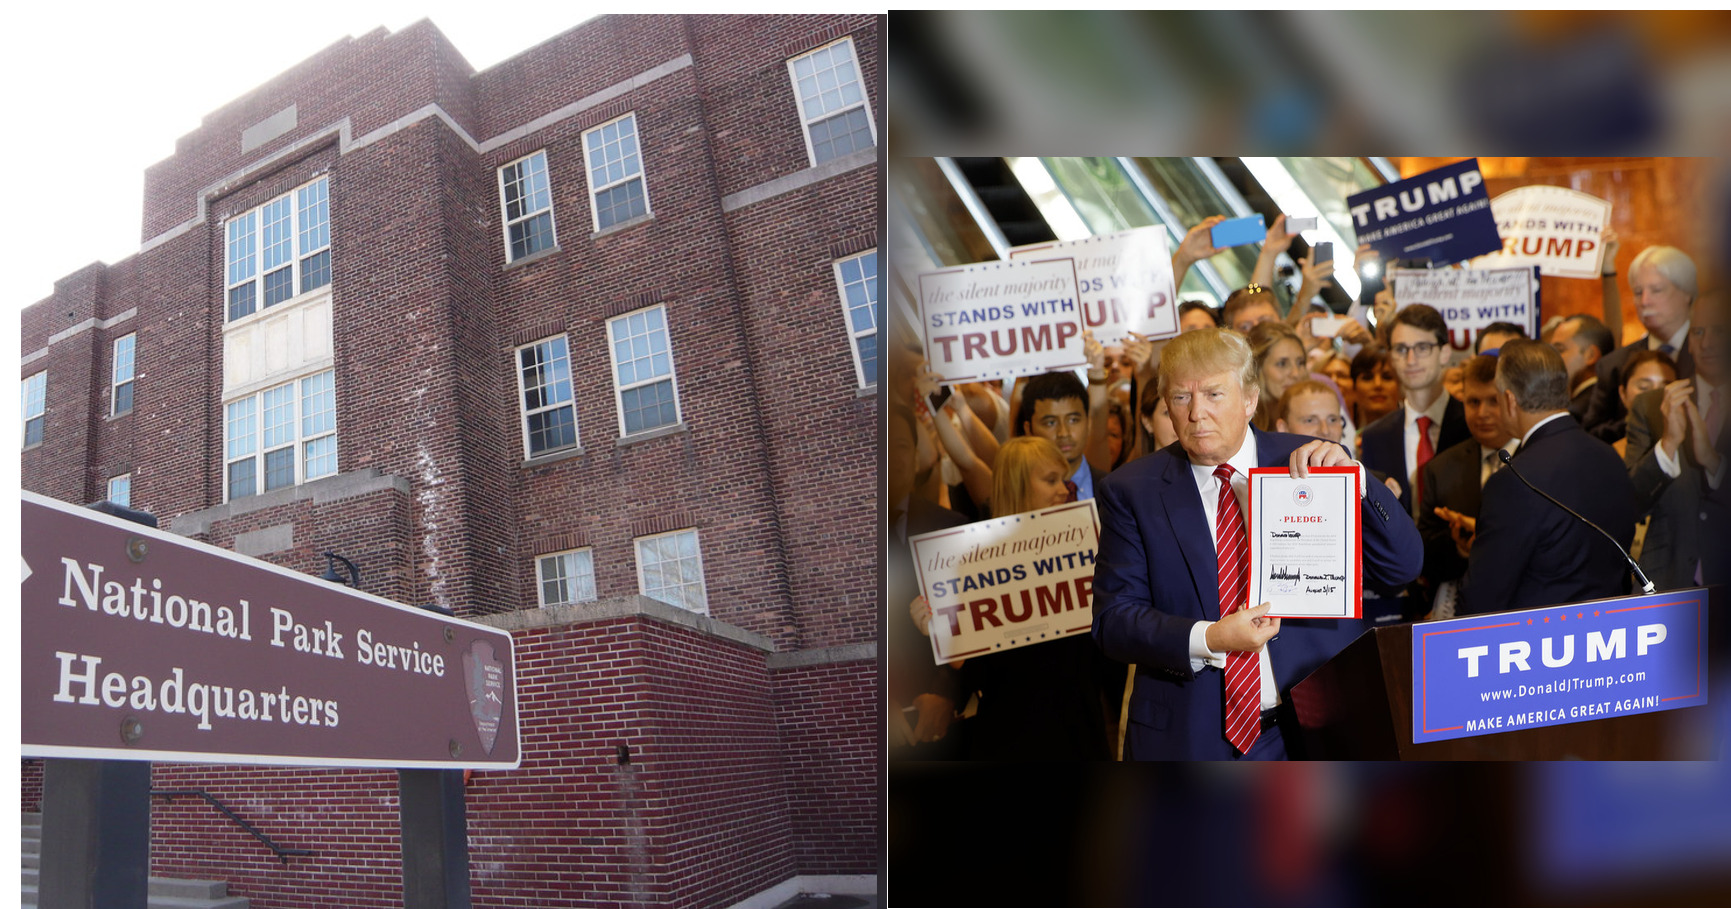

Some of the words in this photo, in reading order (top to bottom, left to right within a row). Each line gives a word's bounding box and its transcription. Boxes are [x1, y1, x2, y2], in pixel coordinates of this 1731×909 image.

[1350, 170, 1482, 227] TRUMP
[1383, 217, 1425, 238] AMERICA
[1425, 207, 1455, 225] GREAT
[1554, 219, 1599, 233] WITH
[1500, 237, 1595, 258] RUMP
[959, 282, 1000, 301] silent
[1003, 274, 1070, 297] majority
[931, 304, 1015, 328] STANDS
[1021, 298, 1075, 317] WITH
[1477, 303, 1526, 320] WITH
[933, 321, 1078, 363] TRUMP
[1284, 515, 1323, 523] PLEDGE
[927, 552, 957, 572] the
[958, 544, 1007, 565] silent
[1011, 524, 1089, 555] majority
[932, 564, 1027, 598] STANDS
[1033, 548, 1096, 576] WITH
[58, 556, 252, 641] National
[269, 607, 345, 659] Park
[357, 628, 446, 677] Service
[937, 575, 1095, 638] TRUMP
[1457, 623, 1668, 678] TRUMP
[53, 651, 340, 731] Headquarters
[1480, 671, 1646, 702] www.DonaldJTrump.com
[1466, 716, 1503, 732] MAKE
[1506, 708, 1566, 727] AMERICA
[1570, 702, 1611, 718] GREAT
[1614, 695, 1660, 712] AGAIN!
